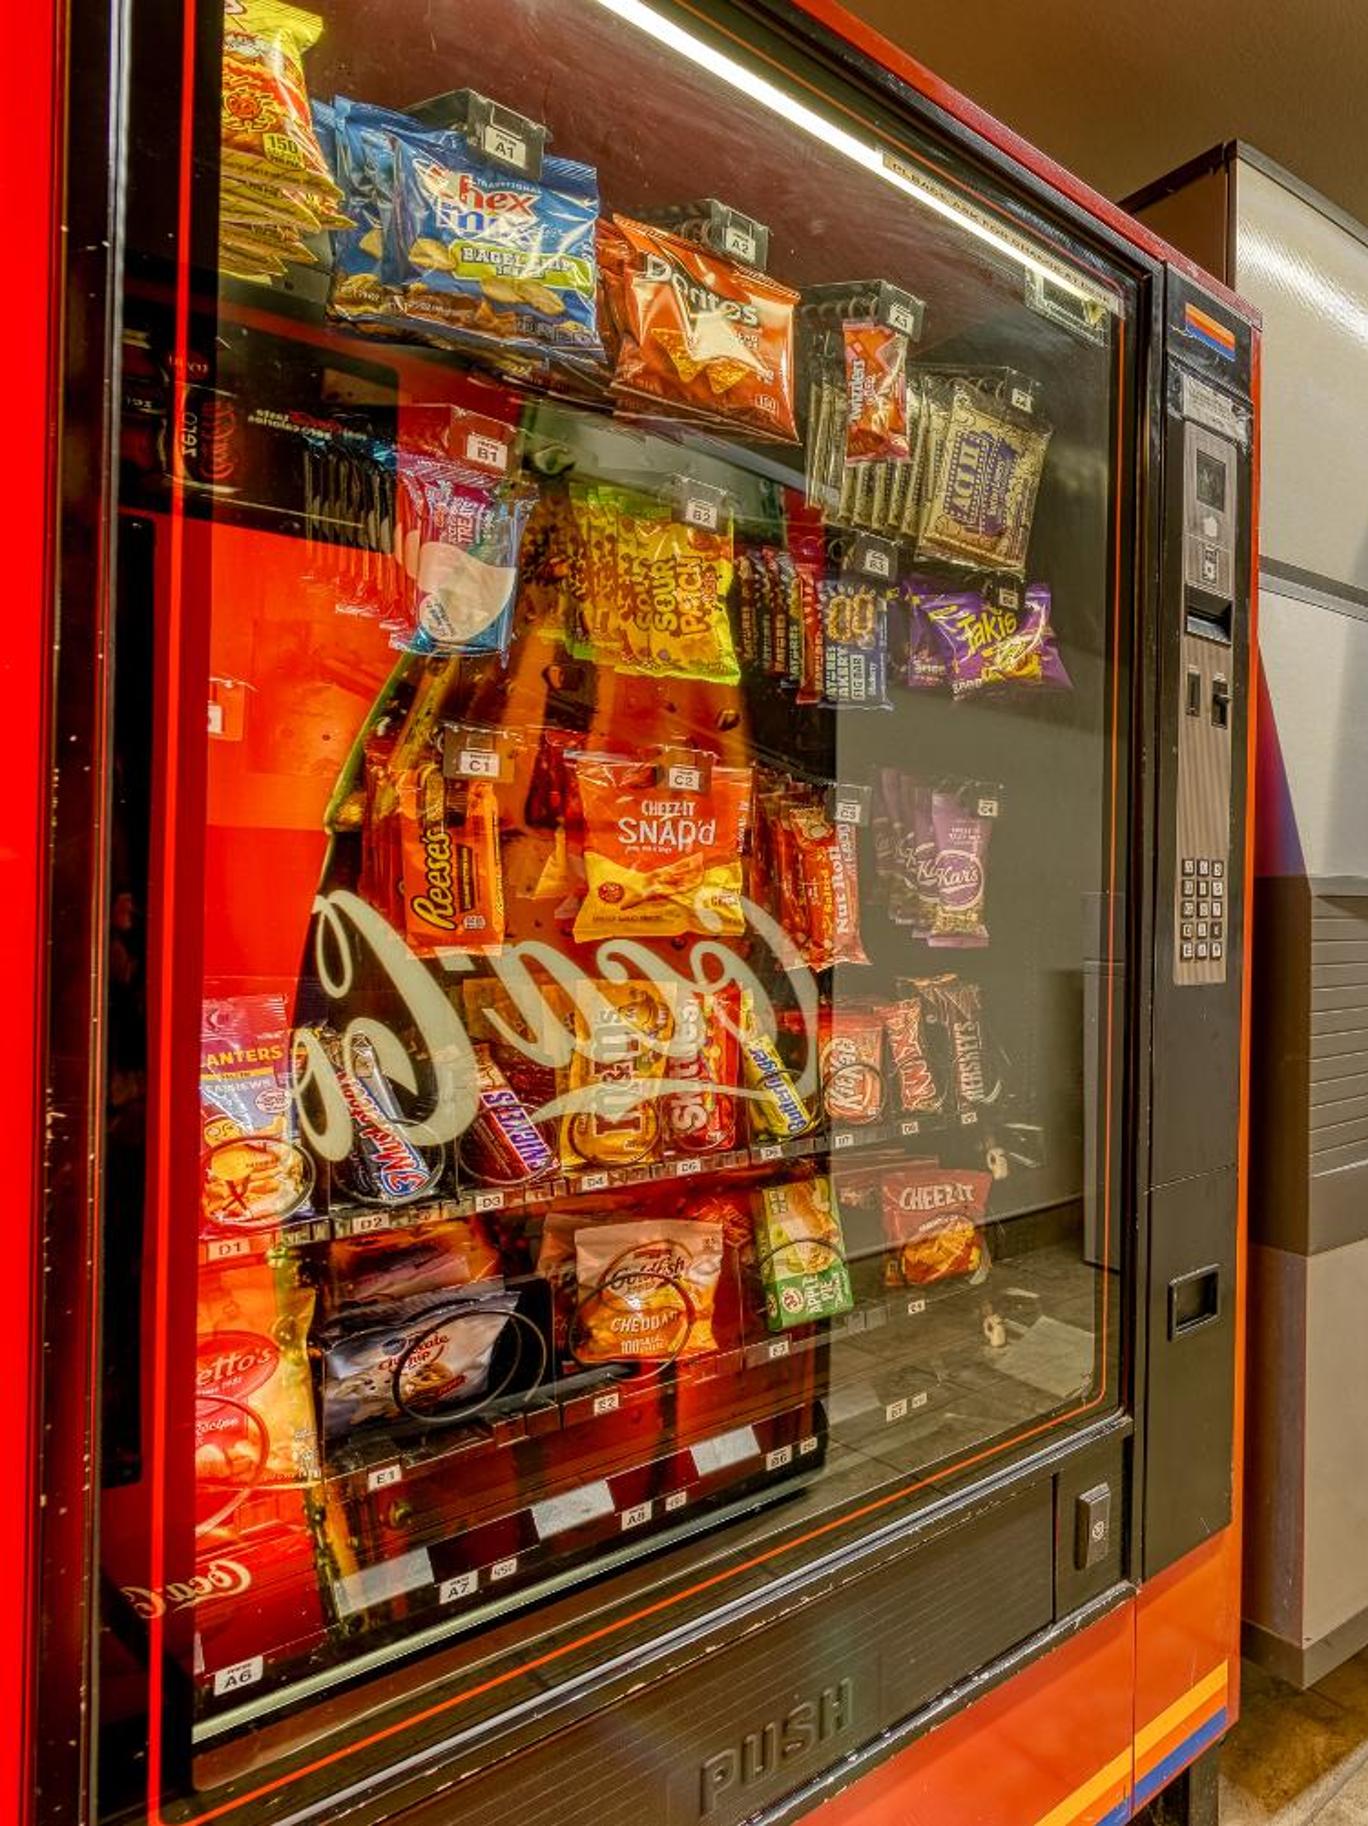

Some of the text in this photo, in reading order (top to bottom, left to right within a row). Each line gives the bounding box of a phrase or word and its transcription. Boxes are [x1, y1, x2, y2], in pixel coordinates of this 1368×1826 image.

[495, 142, 514, 159] A1
[732, 240, 749, 254] A2
[461, 246, 526, 266] BAGEL
[477, 449, 497, 462] B1
[693, 510, 711, 523] B2
[652, 560, 678, 632] SOUR
[959, 608, 1018, 649] Takis
[851, 681, 864, 699] FIG
[469, 760, 490, 772] C1
[674, 775, 693, 786] C2
[204, 1045, 283, 1067] ANTERS
[746, 1045, 808, 1134] Butterfinger
[481, 1090, 553, 1173] SNICKERS
[483, 1197, 500, 1209] D3
[360, 1217, 382, 1229] D2
[218, 1242, 241, 1256] D1
[197, 1347, 272, 1386] etto's
[377, 1471, 395, 1484] E1
[447, 1582, 471, 1599] A7
[224, 1670, 252, 1689] A6
[700, 1677, 854, 1820] PUSH
